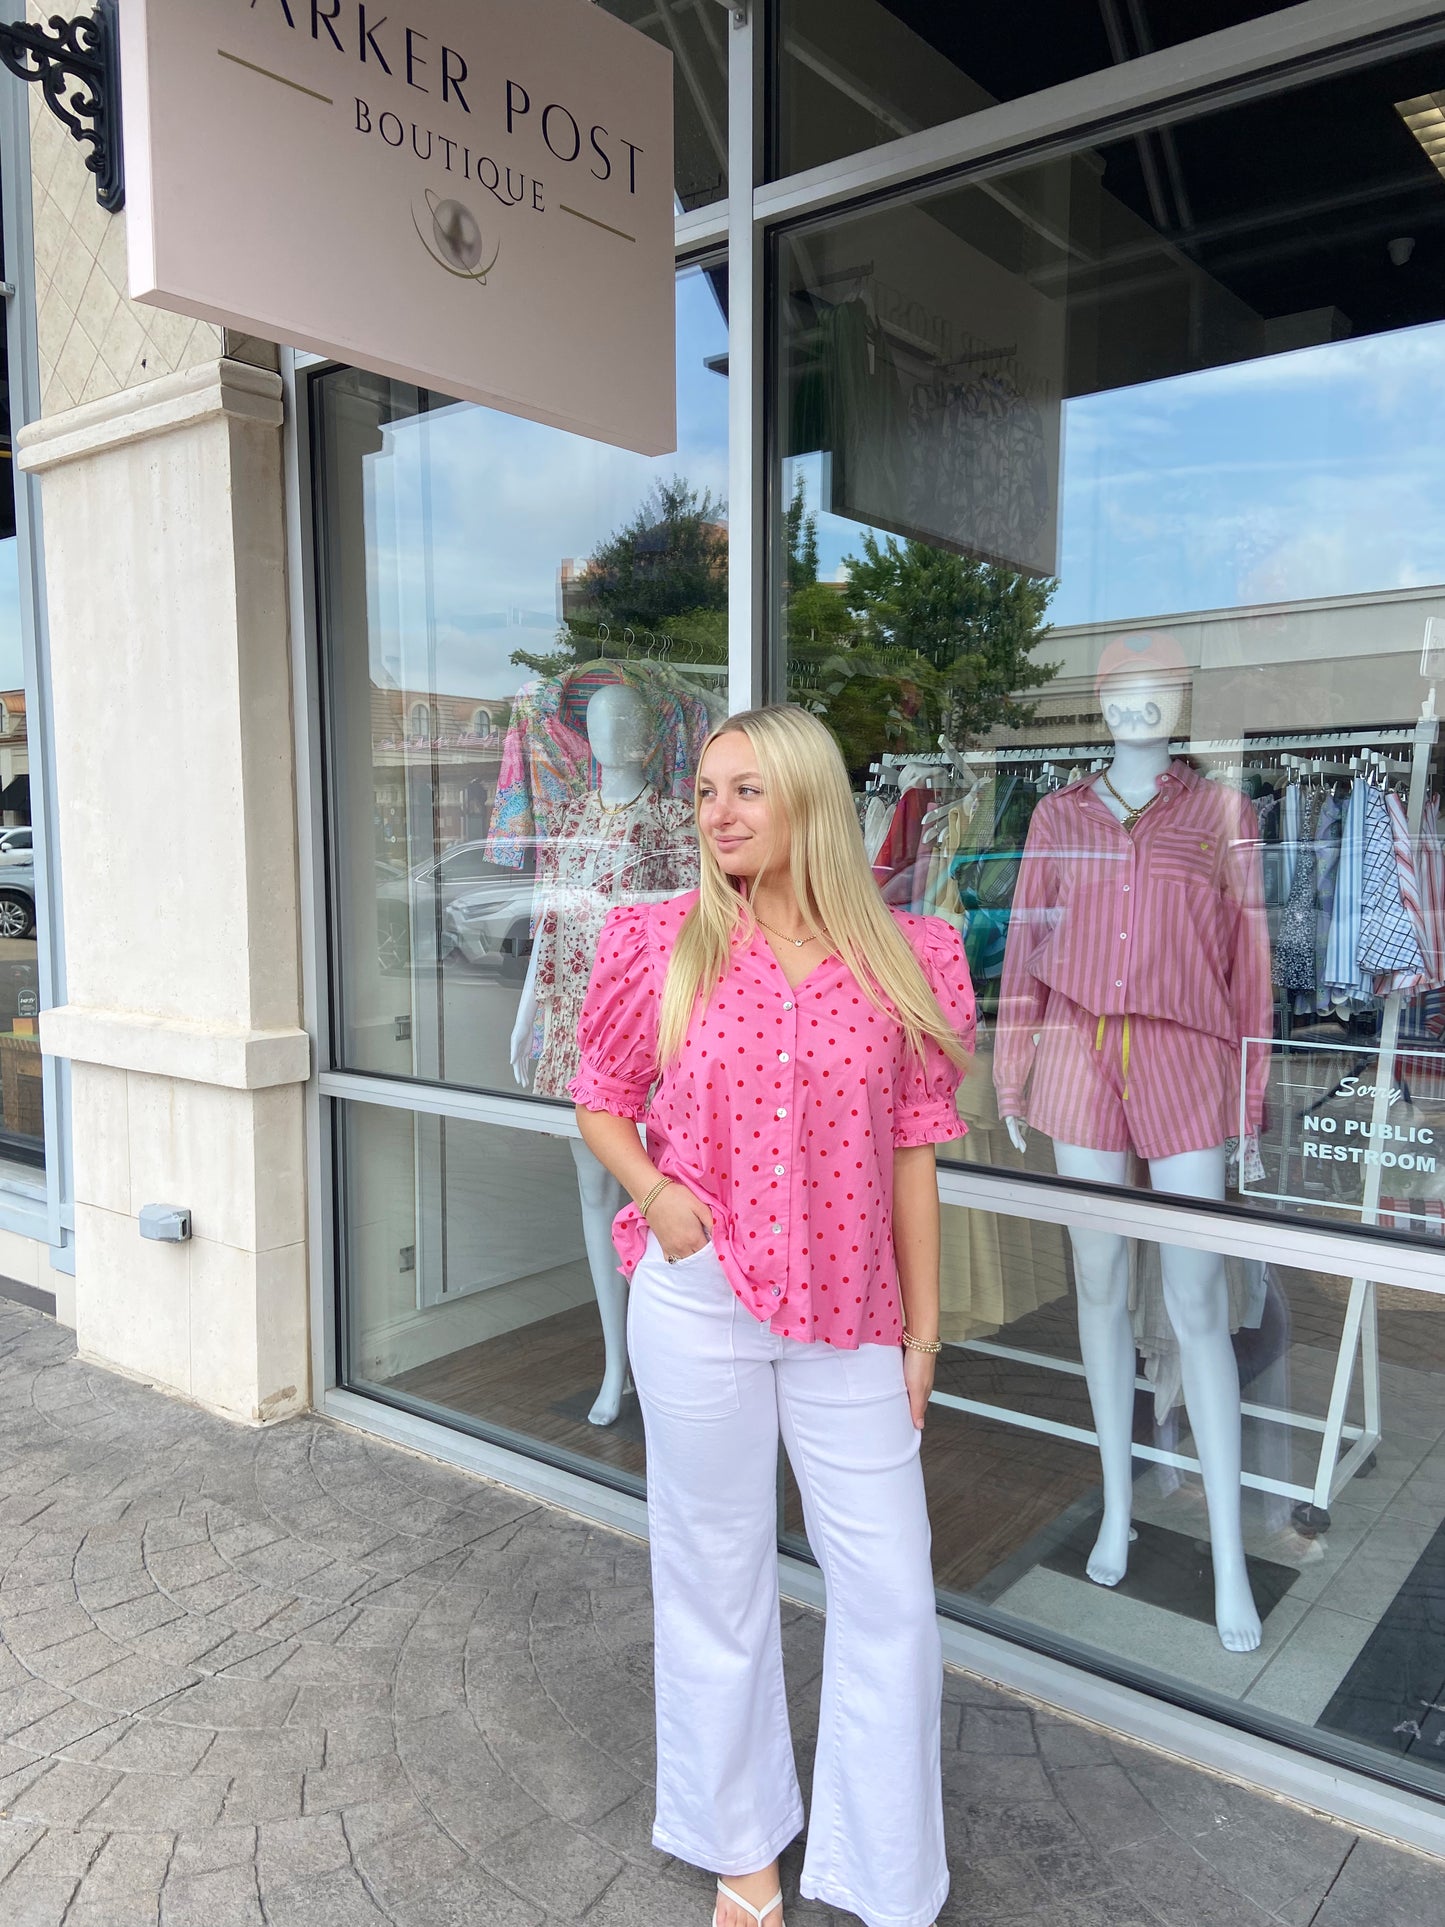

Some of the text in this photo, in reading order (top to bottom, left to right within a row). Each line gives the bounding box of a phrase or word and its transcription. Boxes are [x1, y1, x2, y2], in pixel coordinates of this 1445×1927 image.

[506, 79, 644, 194] POST
[355, 97, 546, 213] BOUTIQUE
[1335, 1076, 1402, 1107] Sorry
[1303, 1115, 1435, 1145] NO PUBLIC
[1303, 1142, 1437, 1173] RESTROOM
